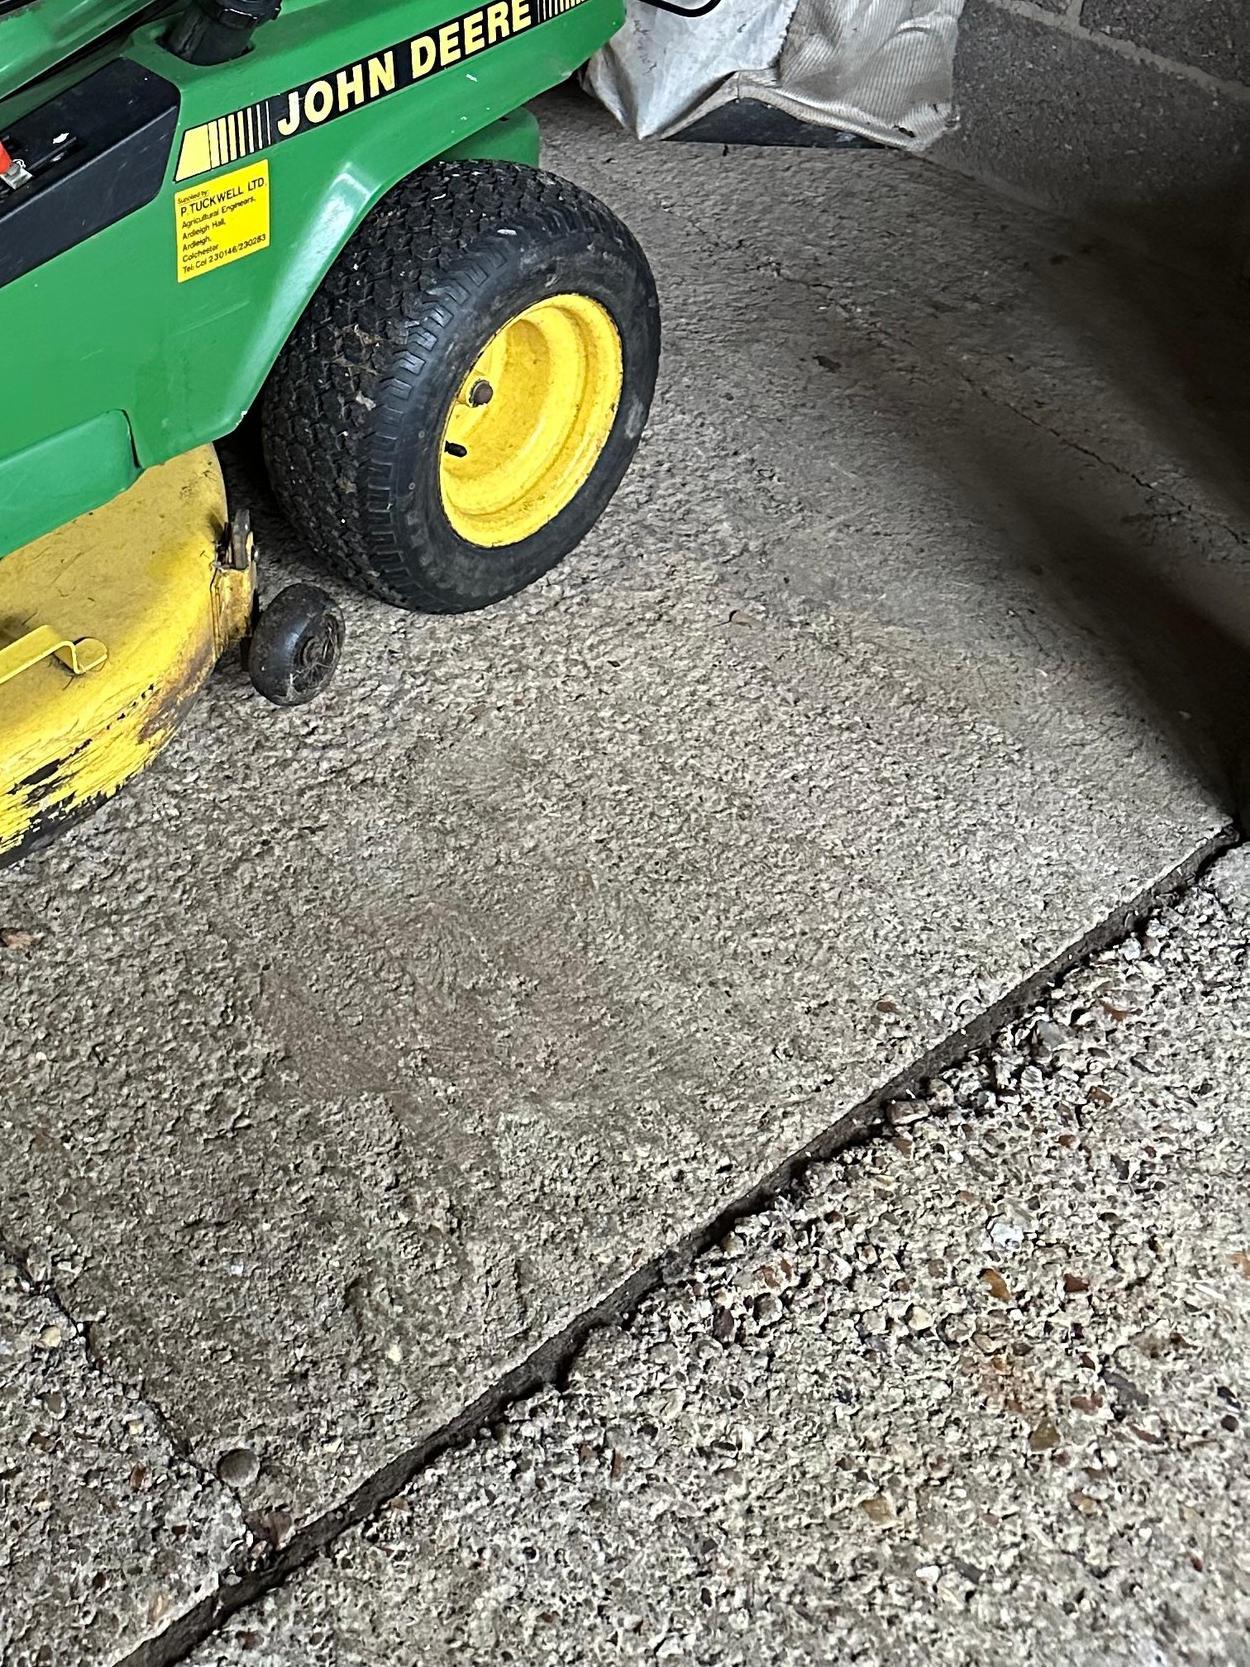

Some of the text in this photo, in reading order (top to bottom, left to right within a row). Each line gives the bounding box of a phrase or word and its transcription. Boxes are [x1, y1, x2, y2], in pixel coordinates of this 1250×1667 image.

[277, 51, 395, 136] JOHN
[190, 186, 244, 213] TUCKWELL
[248, 177, 268, 191] LTD.
[182, 209, 219, 229] Agricultural
[182, 225, 210, 240] Ardleigh
[182, 244, 219, 263] Colchester
